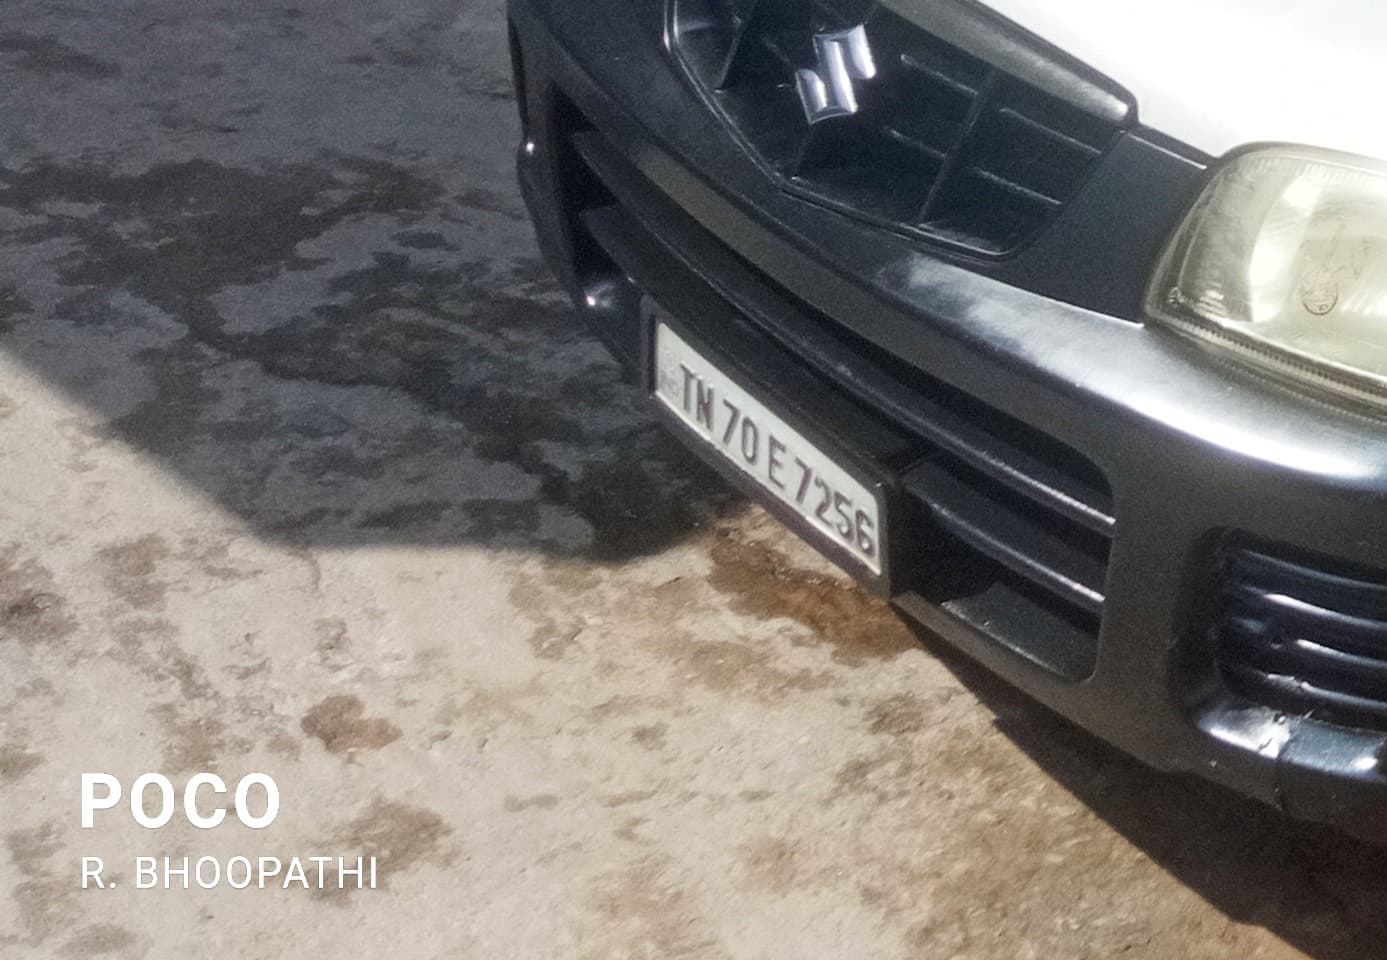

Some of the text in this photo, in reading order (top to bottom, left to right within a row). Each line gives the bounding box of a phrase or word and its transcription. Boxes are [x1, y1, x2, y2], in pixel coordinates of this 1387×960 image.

[679, 361, 876, 558] TN 70 E 7256
